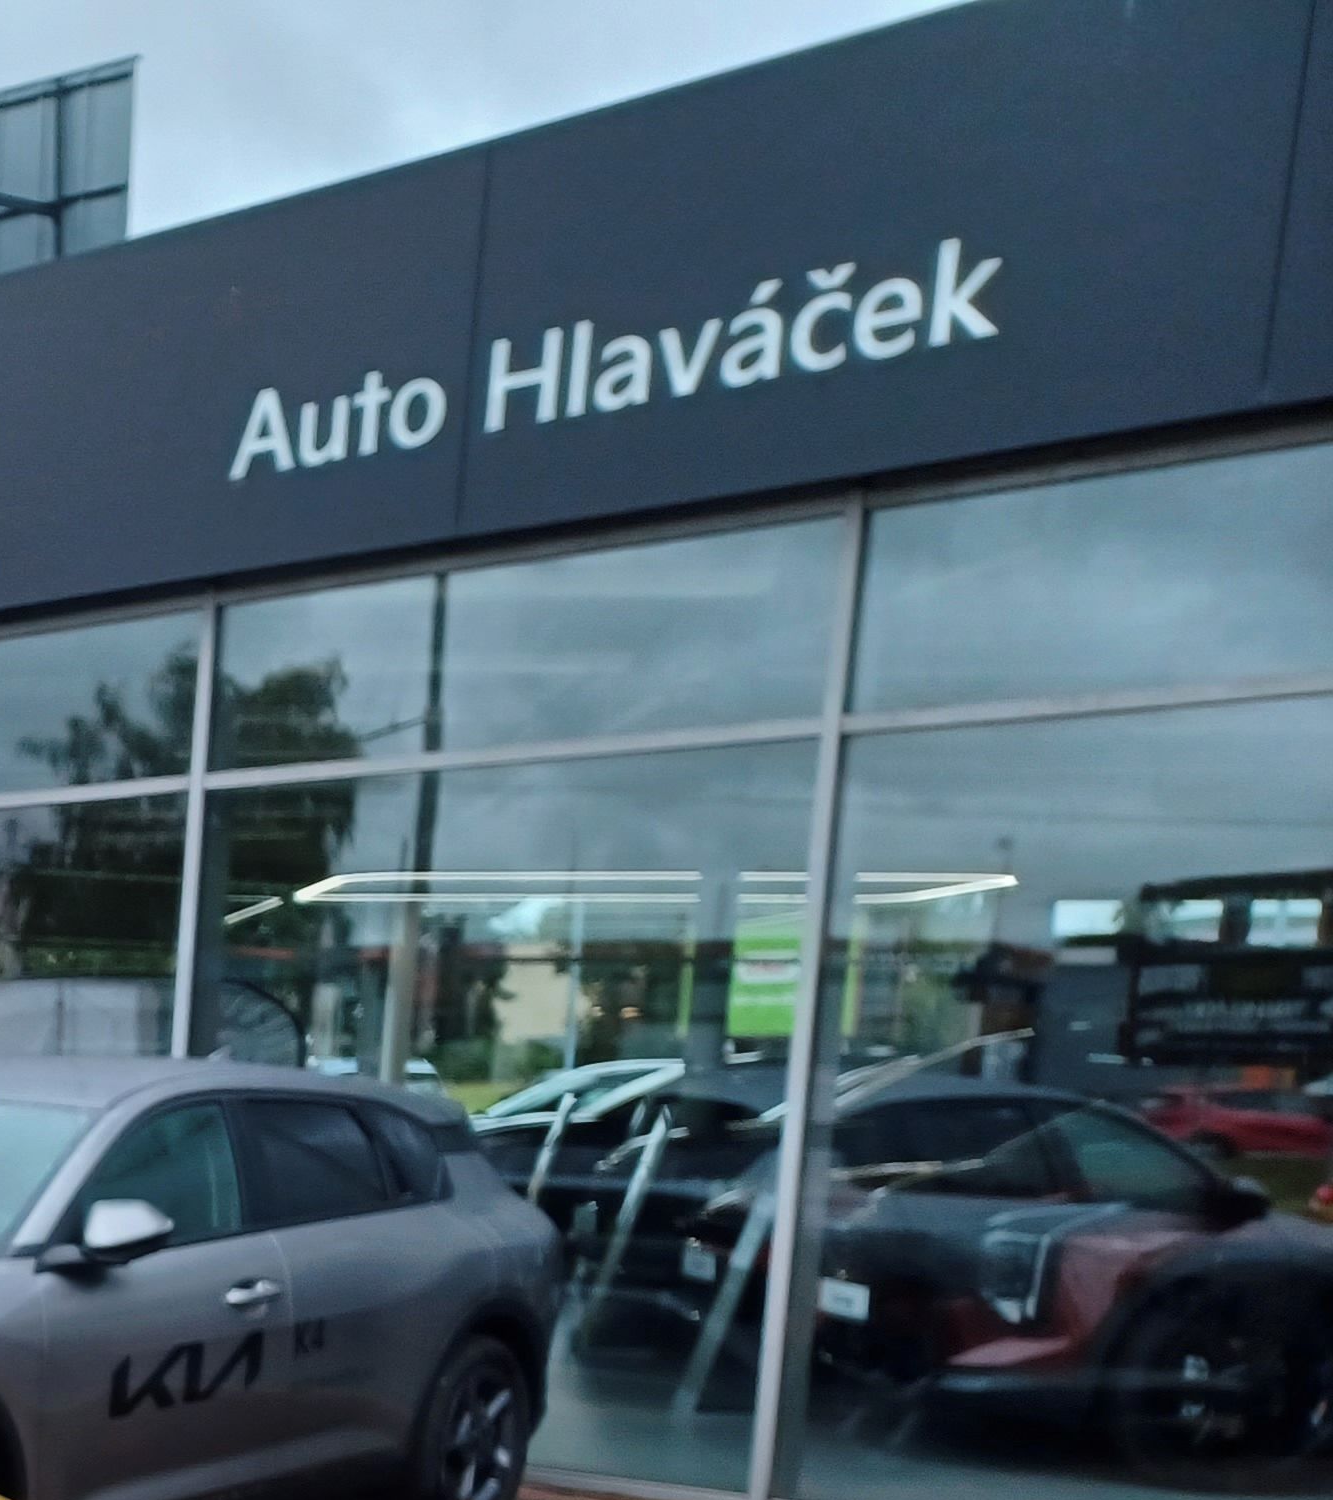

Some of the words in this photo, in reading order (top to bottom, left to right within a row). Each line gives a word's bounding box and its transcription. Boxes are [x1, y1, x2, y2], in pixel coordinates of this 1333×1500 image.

[227, 369, 448, 482] Auto
[483, 236, 1004, 435] Hlaváček
[109, 1328, 264, 1419] KIA
